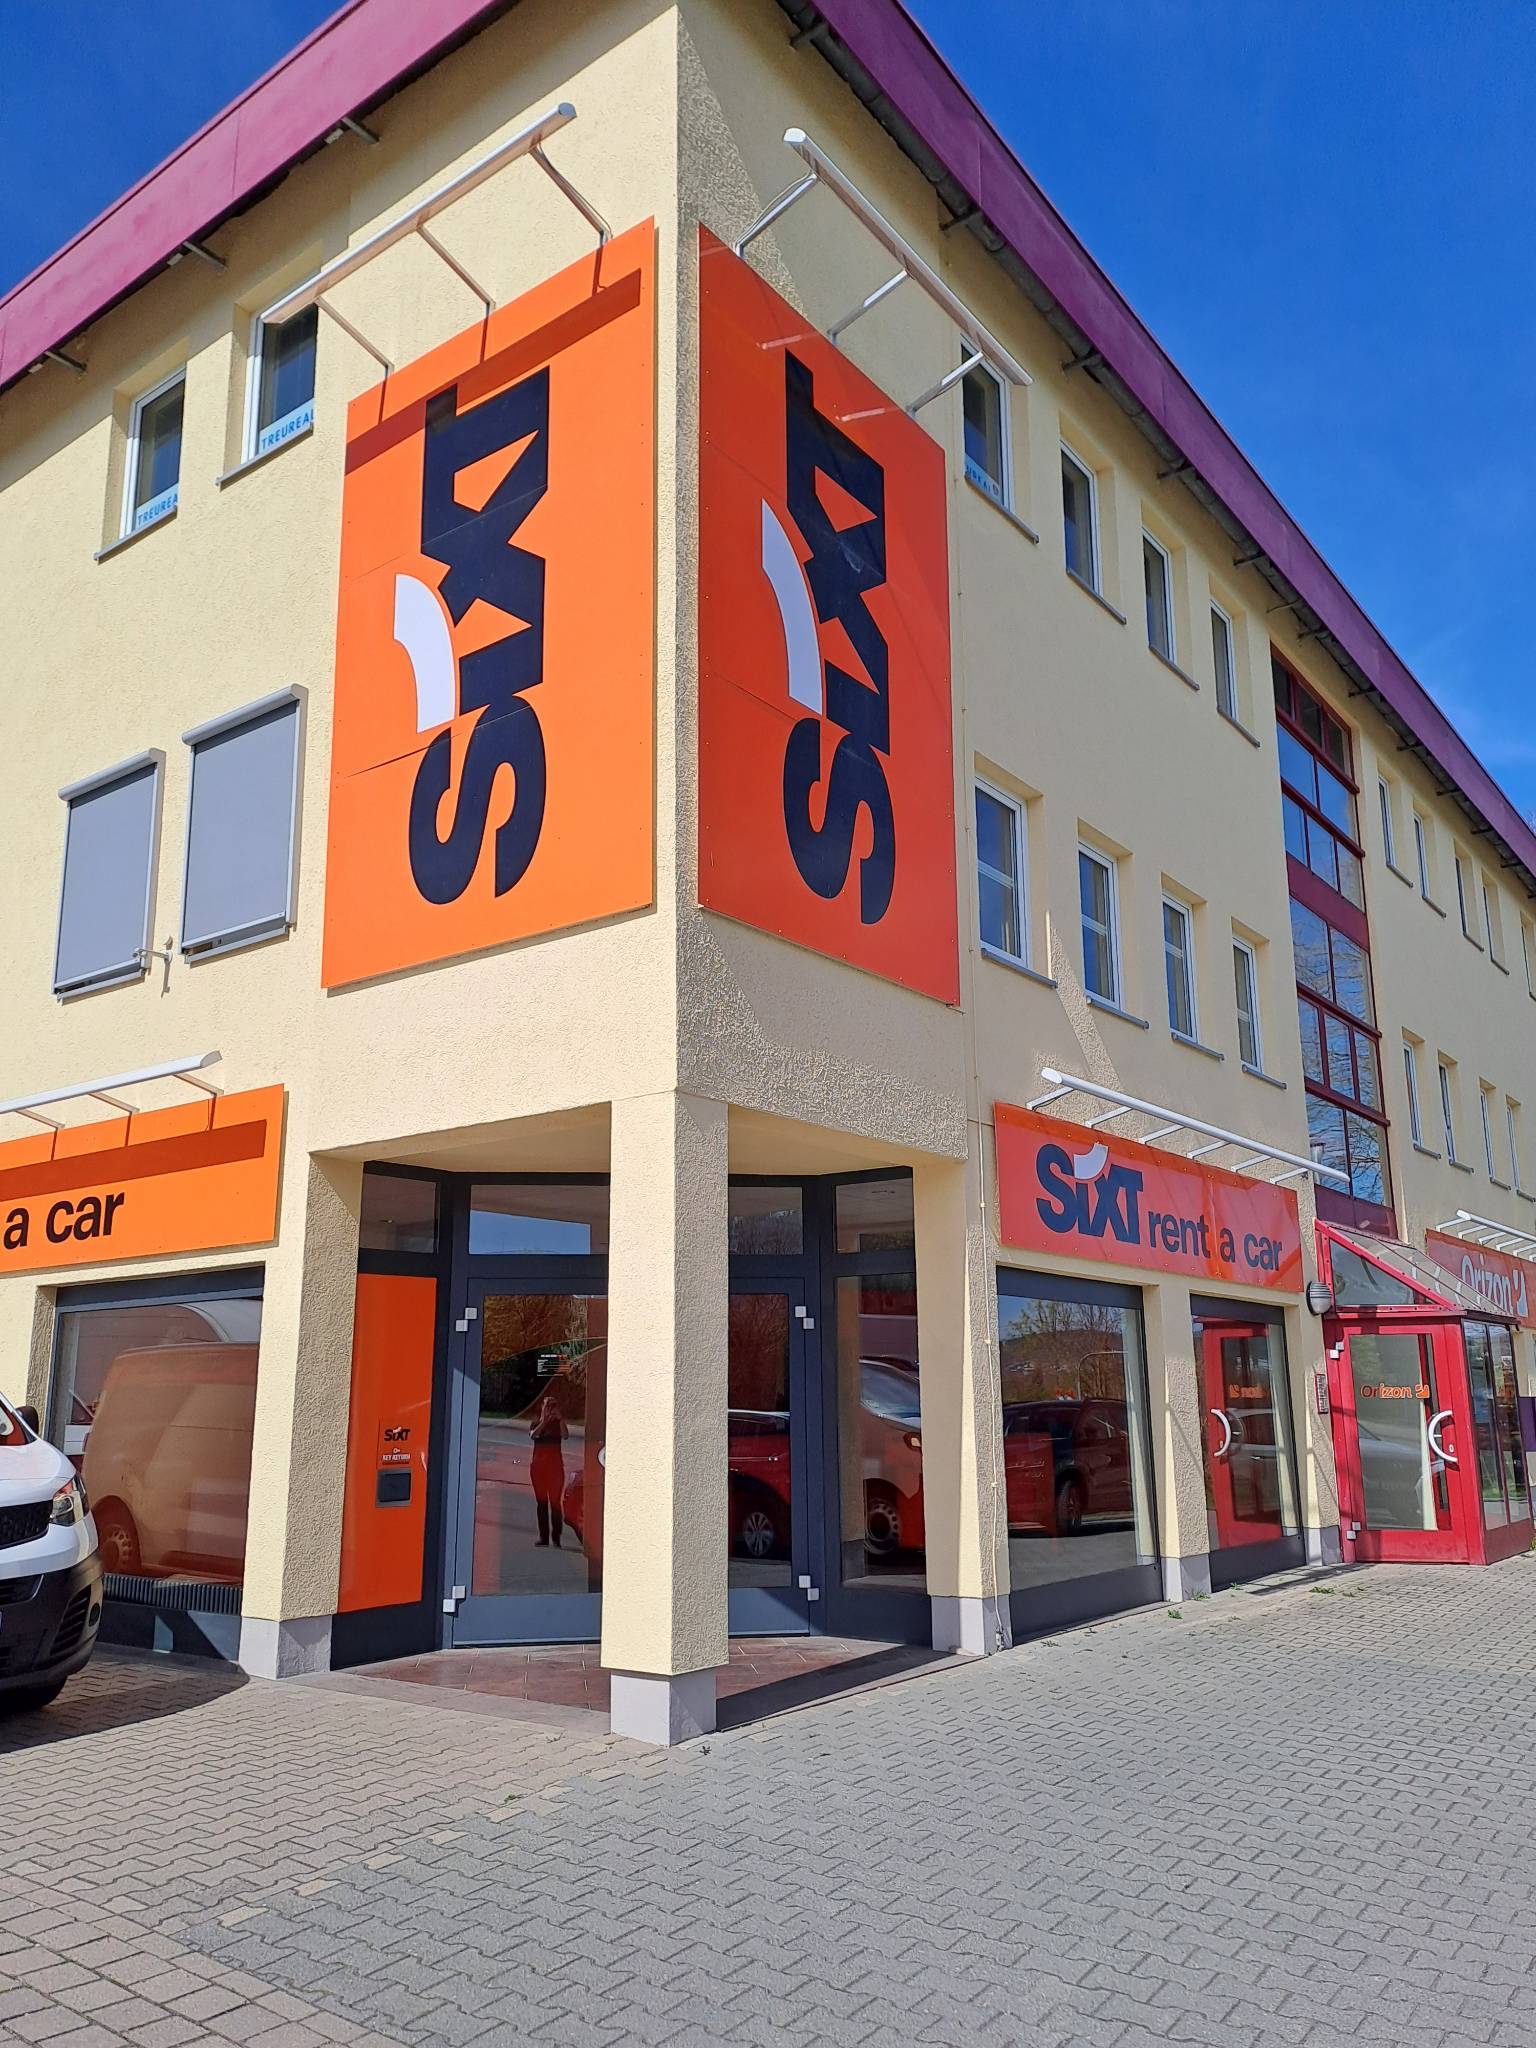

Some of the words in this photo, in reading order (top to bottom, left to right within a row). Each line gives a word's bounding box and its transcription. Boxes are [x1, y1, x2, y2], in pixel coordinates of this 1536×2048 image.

[3, 1207, 30, 1250] a
[45, 1192, 125, 1244] car
[1148, 1210, 1210, 1259] rent
[1220, 1227, 1236, 1264] a
[1243, 1232, 1283, 1272] car
[1361, 1382, 1412, 1398] Orizon
